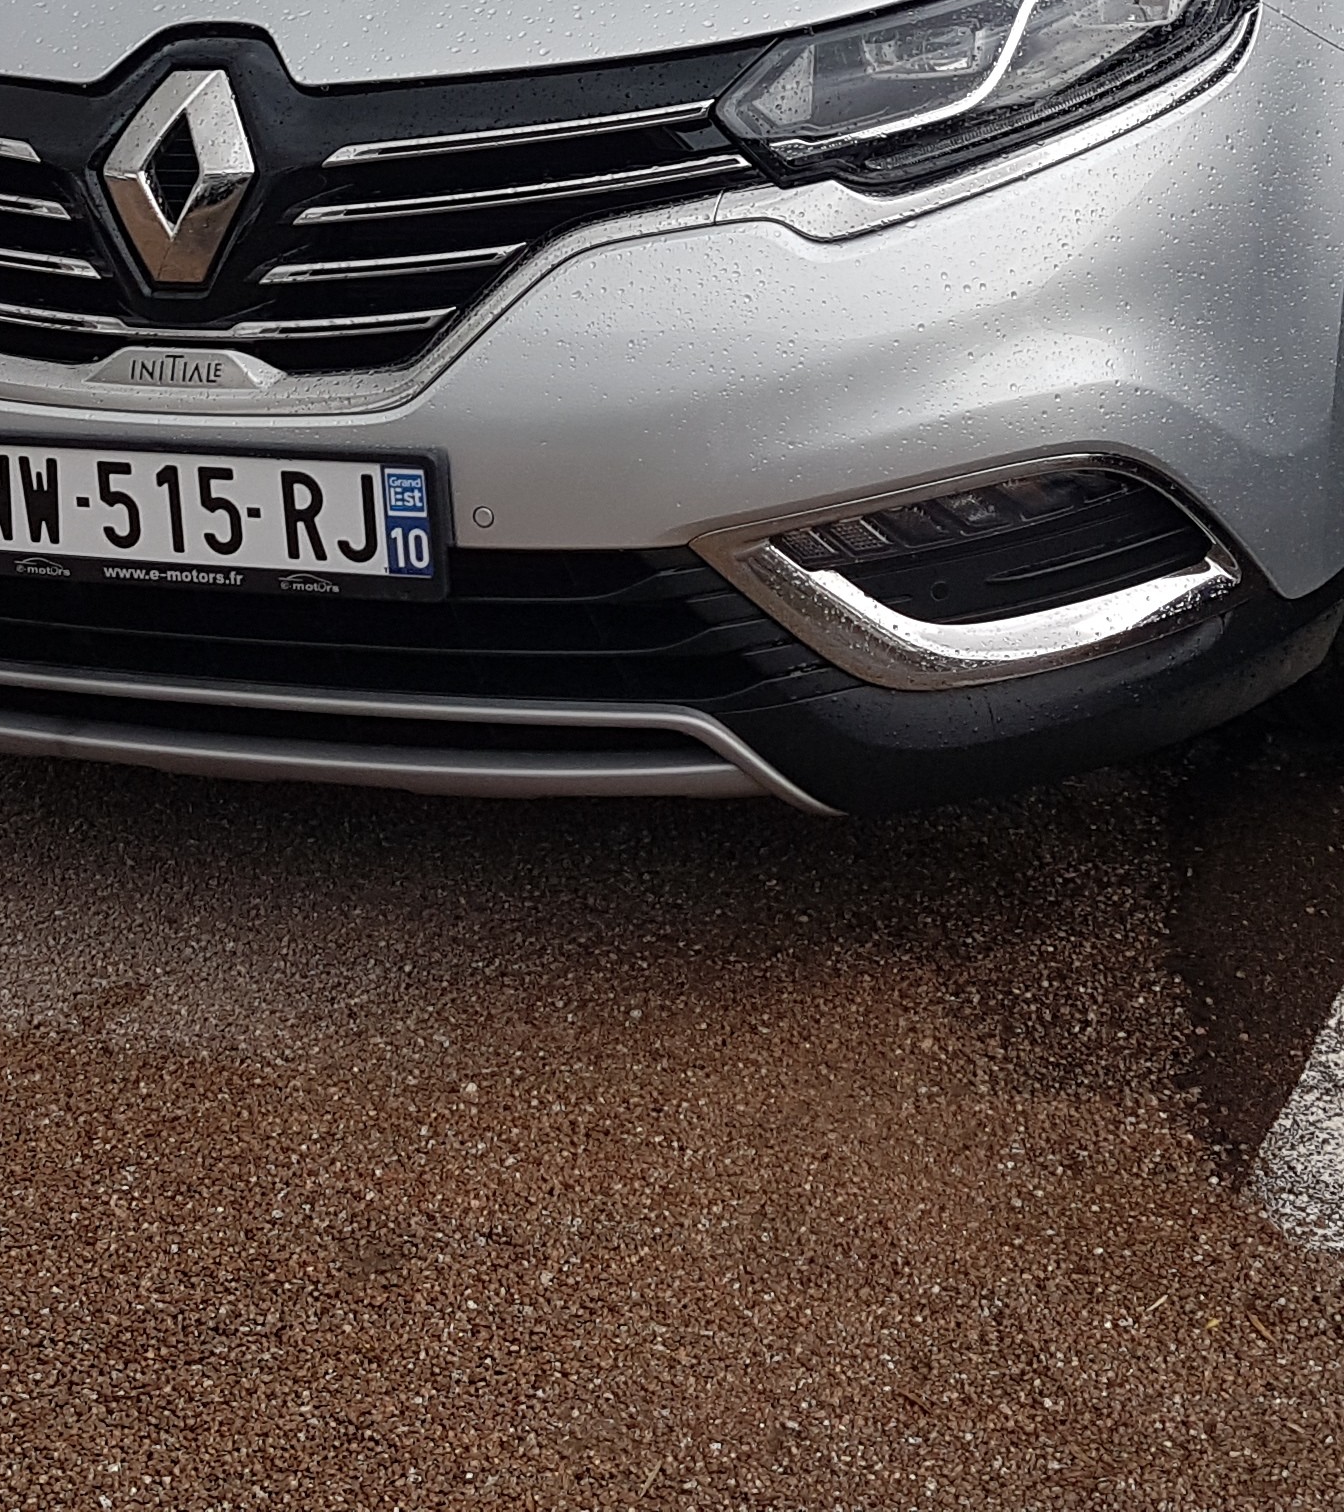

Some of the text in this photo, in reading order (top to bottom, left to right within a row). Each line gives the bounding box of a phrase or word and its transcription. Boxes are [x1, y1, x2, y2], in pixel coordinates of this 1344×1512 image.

[130, 354, 223, 383] INITIALE
[389, 477, 422, 488] Grand
[390, 487, 423, 507] Est
[390, 527, 430, 569] 10
[103, 567, 244, 586] www.e-motors.fr
